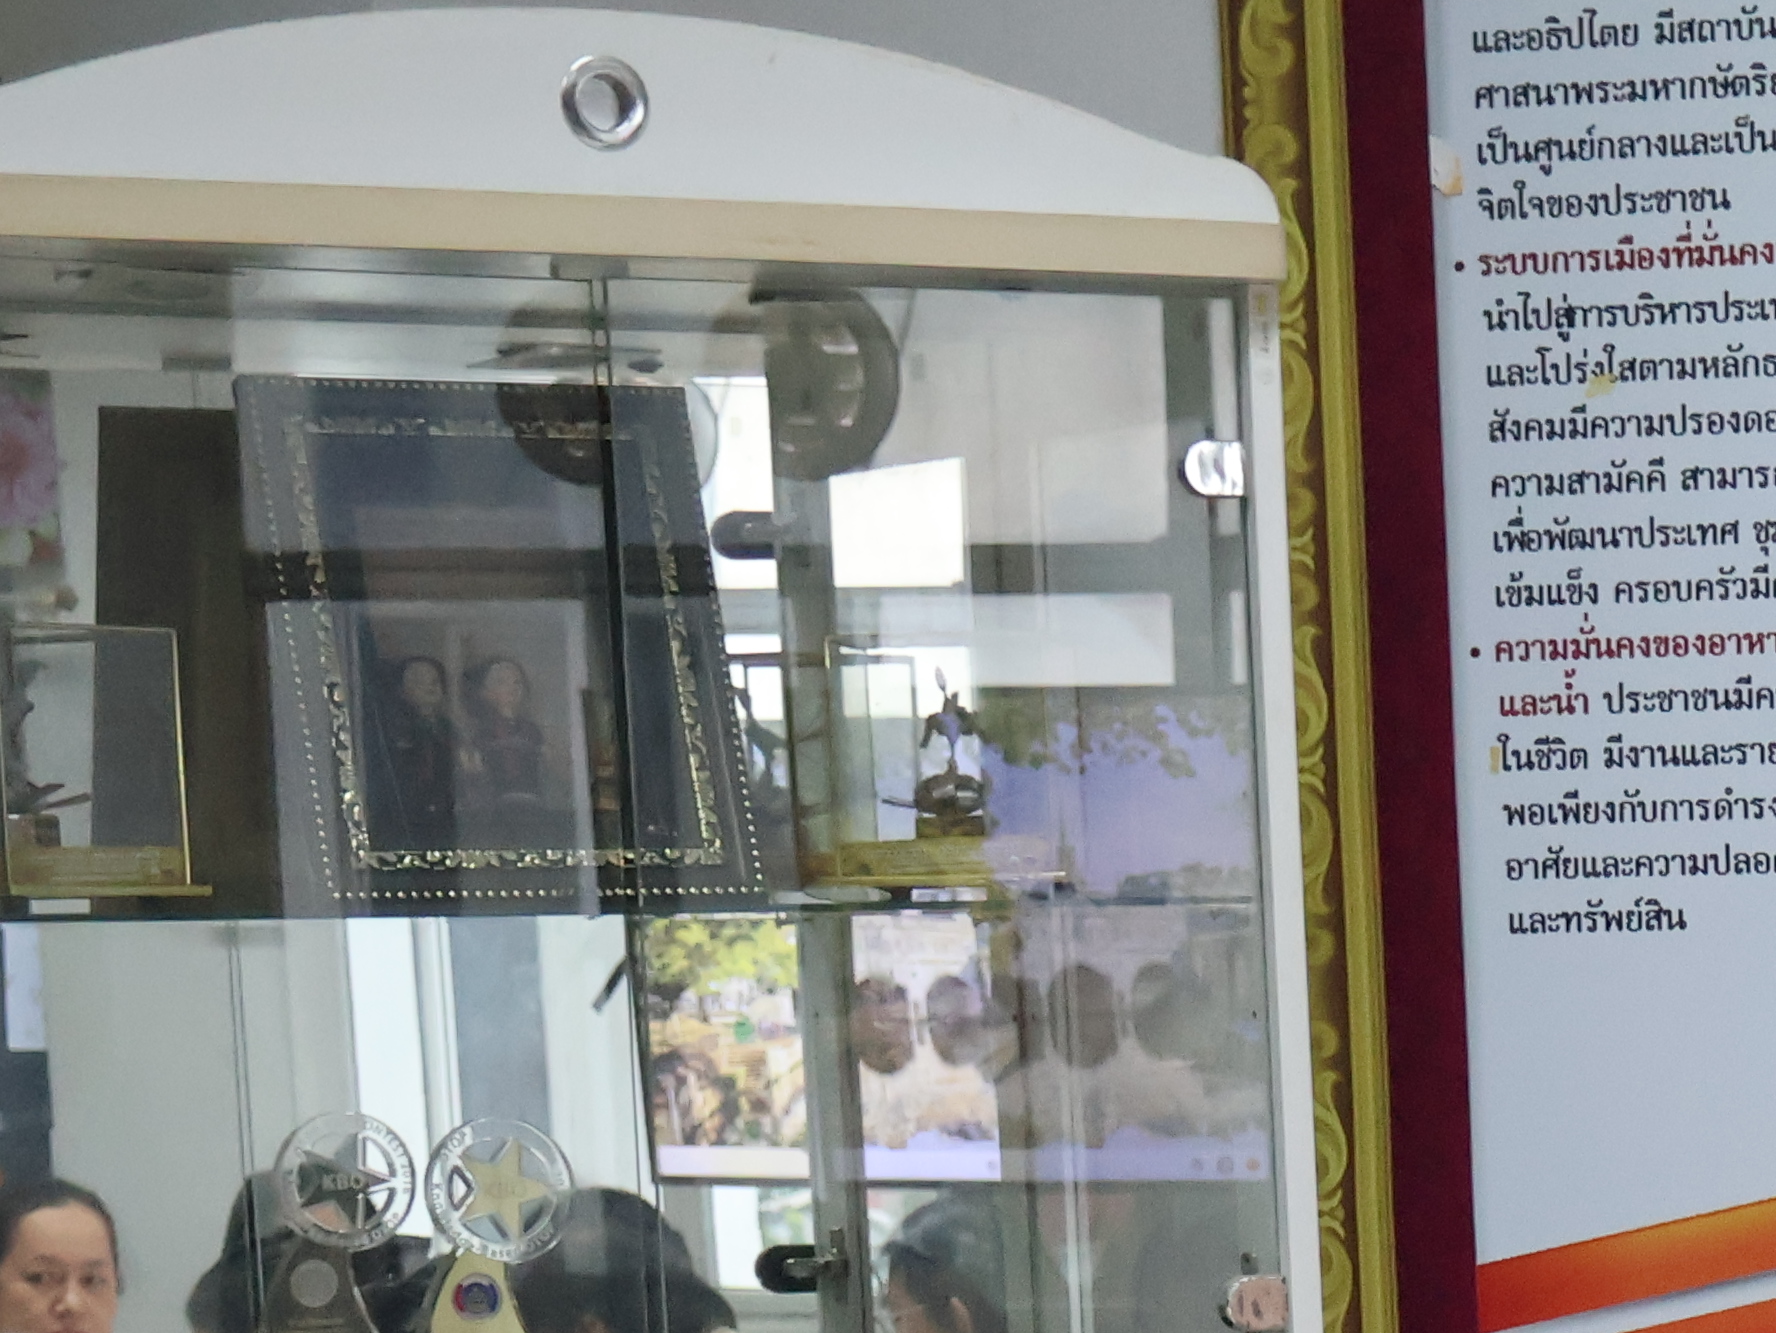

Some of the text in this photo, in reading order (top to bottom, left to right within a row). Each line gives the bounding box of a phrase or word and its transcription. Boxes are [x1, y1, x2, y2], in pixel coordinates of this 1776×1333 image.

[1473, 8, 1639, 53] และอธิปไตย
[1477, 180, 1731, 221] จิตใจของประชาชน
[1491, 456, 1666, 498] ความสามัคคี
[1493, 505, 1739, 553] เพื่อพัฒนาประเทศ
[1495, 567, 1599, 608] เข้มแข็ง
[1500, 668, 1589, 717] และน้ำ
[1497, 733, 1588, 772] ในชีวิต
[1509, 896, 1687, 934] และทรัพย์สิน
